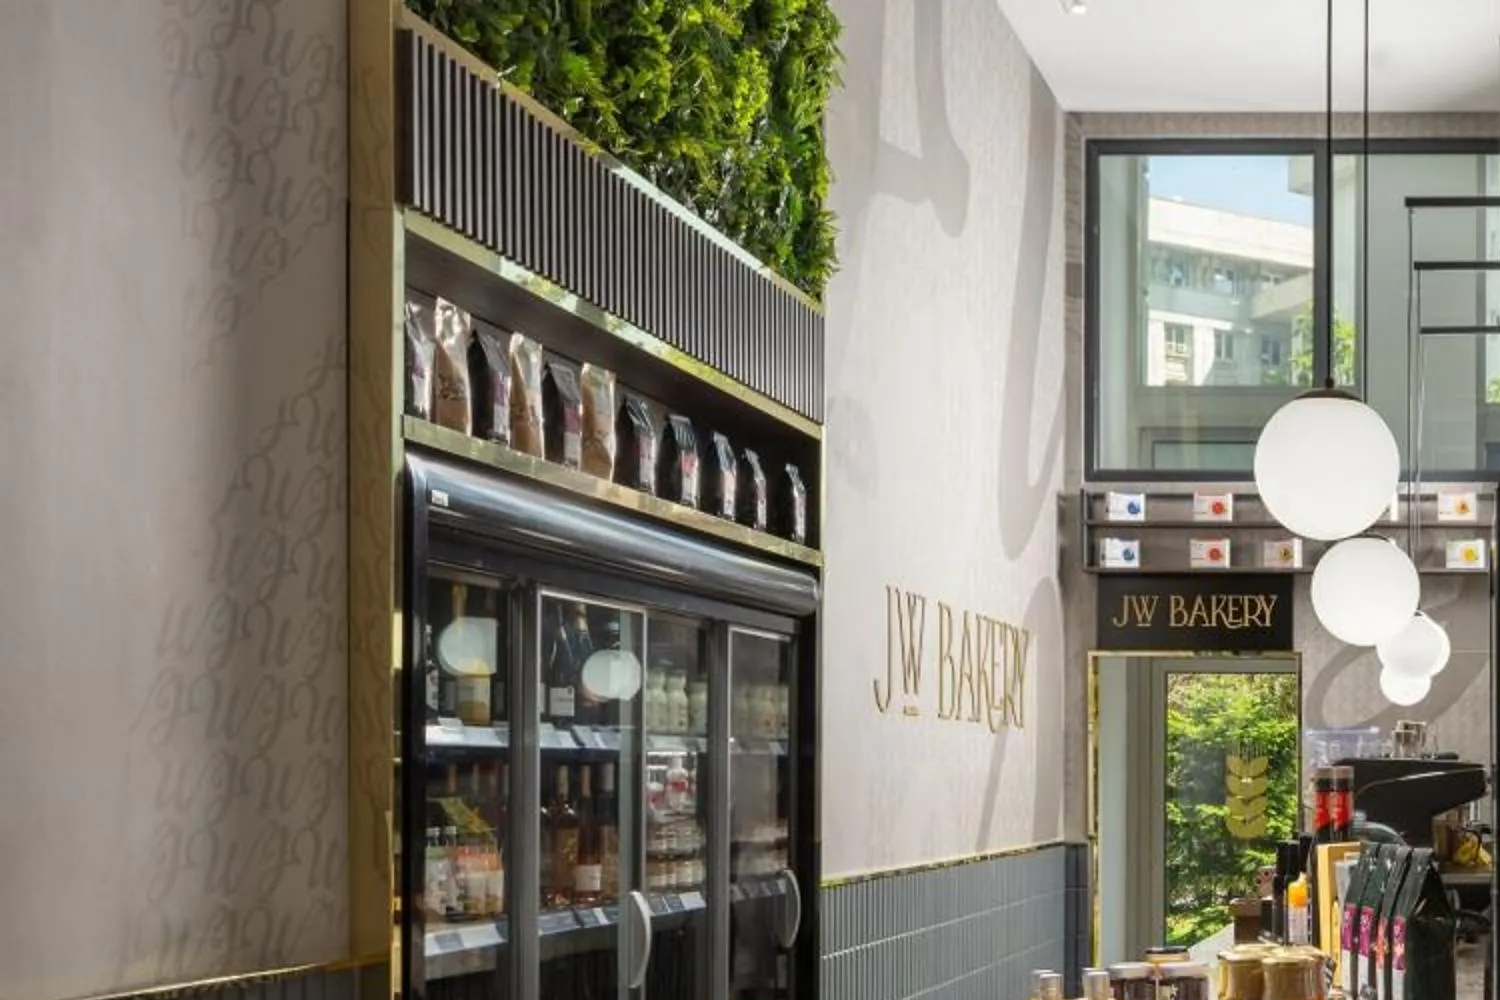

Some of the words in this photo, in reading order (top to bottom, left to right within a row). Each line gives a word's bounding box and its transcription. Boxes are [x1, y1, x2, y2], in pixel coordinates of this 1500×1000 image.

[1112, 594, 1159, 627] JW
[1169, 594, 1278, 629] BAKERY
[874, 584, 926, 716] JW
[937, 600, 1029, 734] BAKERY
